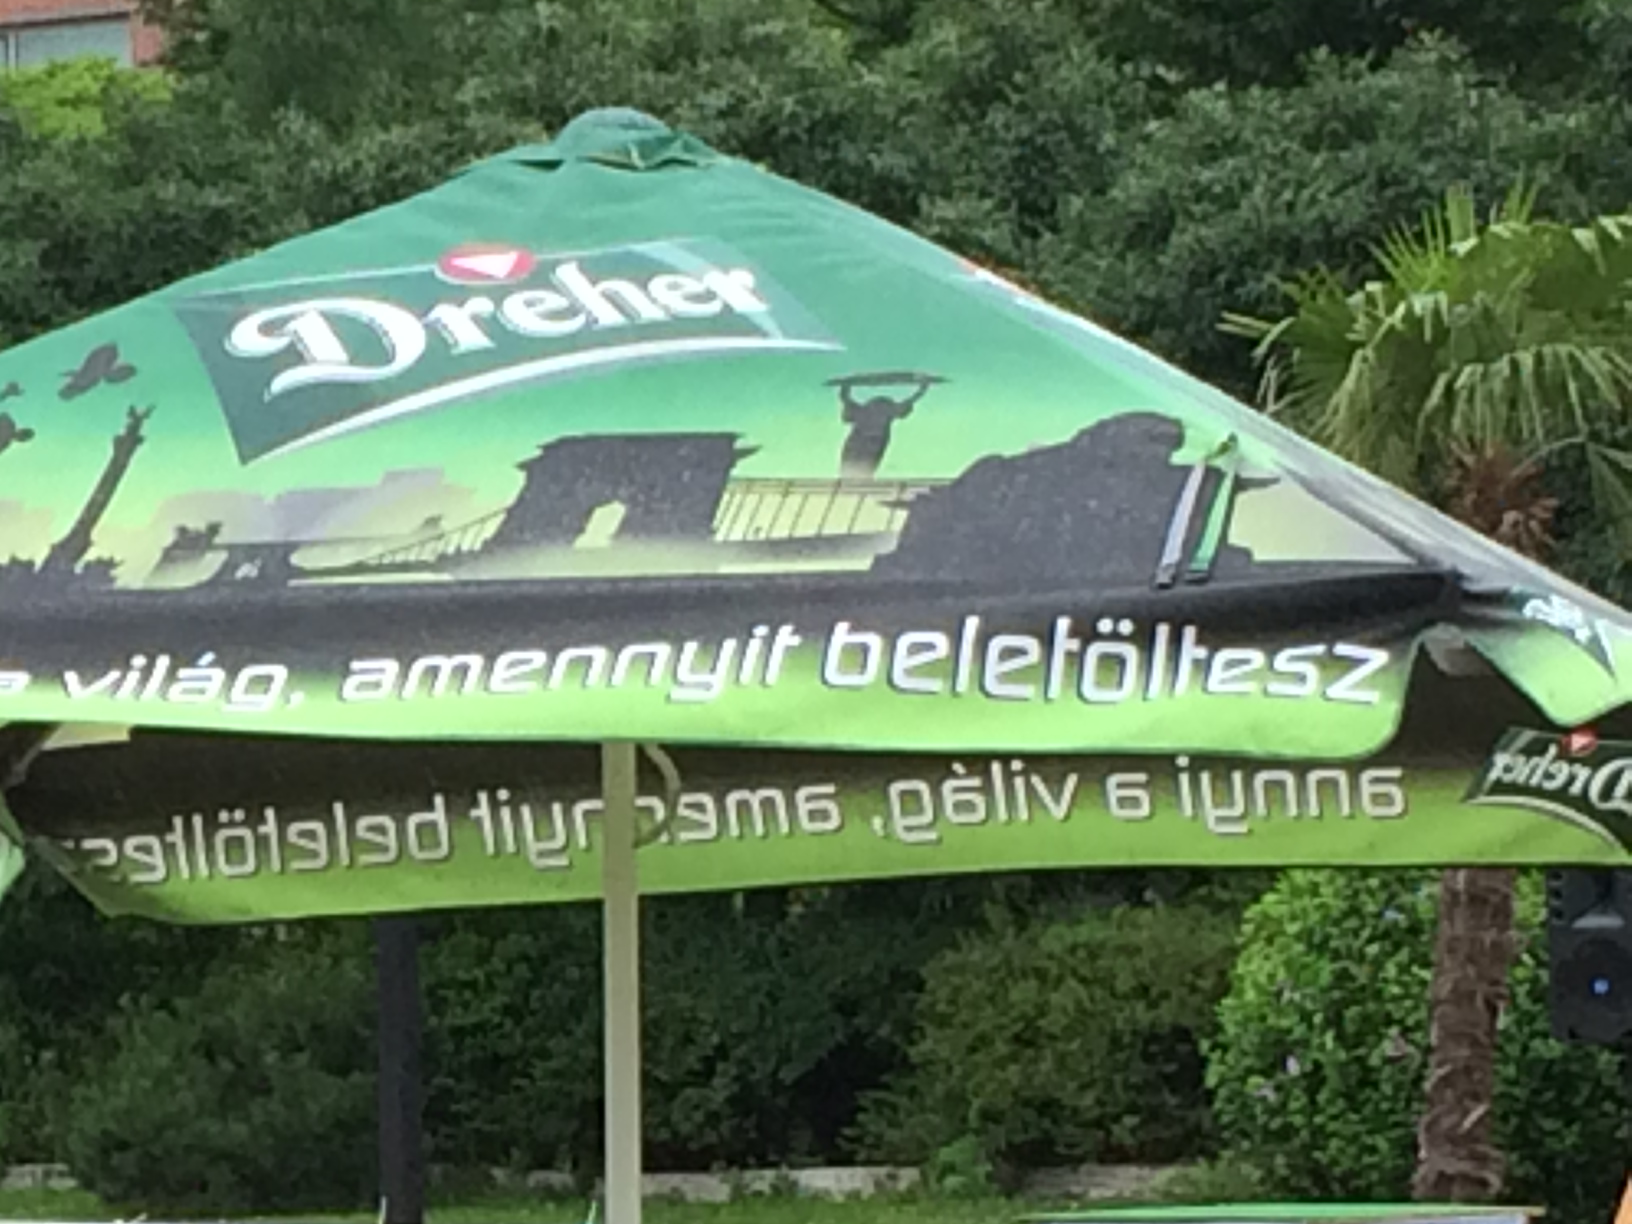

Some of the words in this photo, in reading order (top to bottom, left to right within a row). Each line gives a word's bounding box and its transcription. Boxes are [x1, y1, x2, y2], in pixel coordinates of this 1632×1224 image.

[223, 259, 771, 404] Dreher
[63, 650, 306, 712] világ,
[341, 622, 802, 703] amennyit
[820, 614, 1391, 704] beletöltesz
